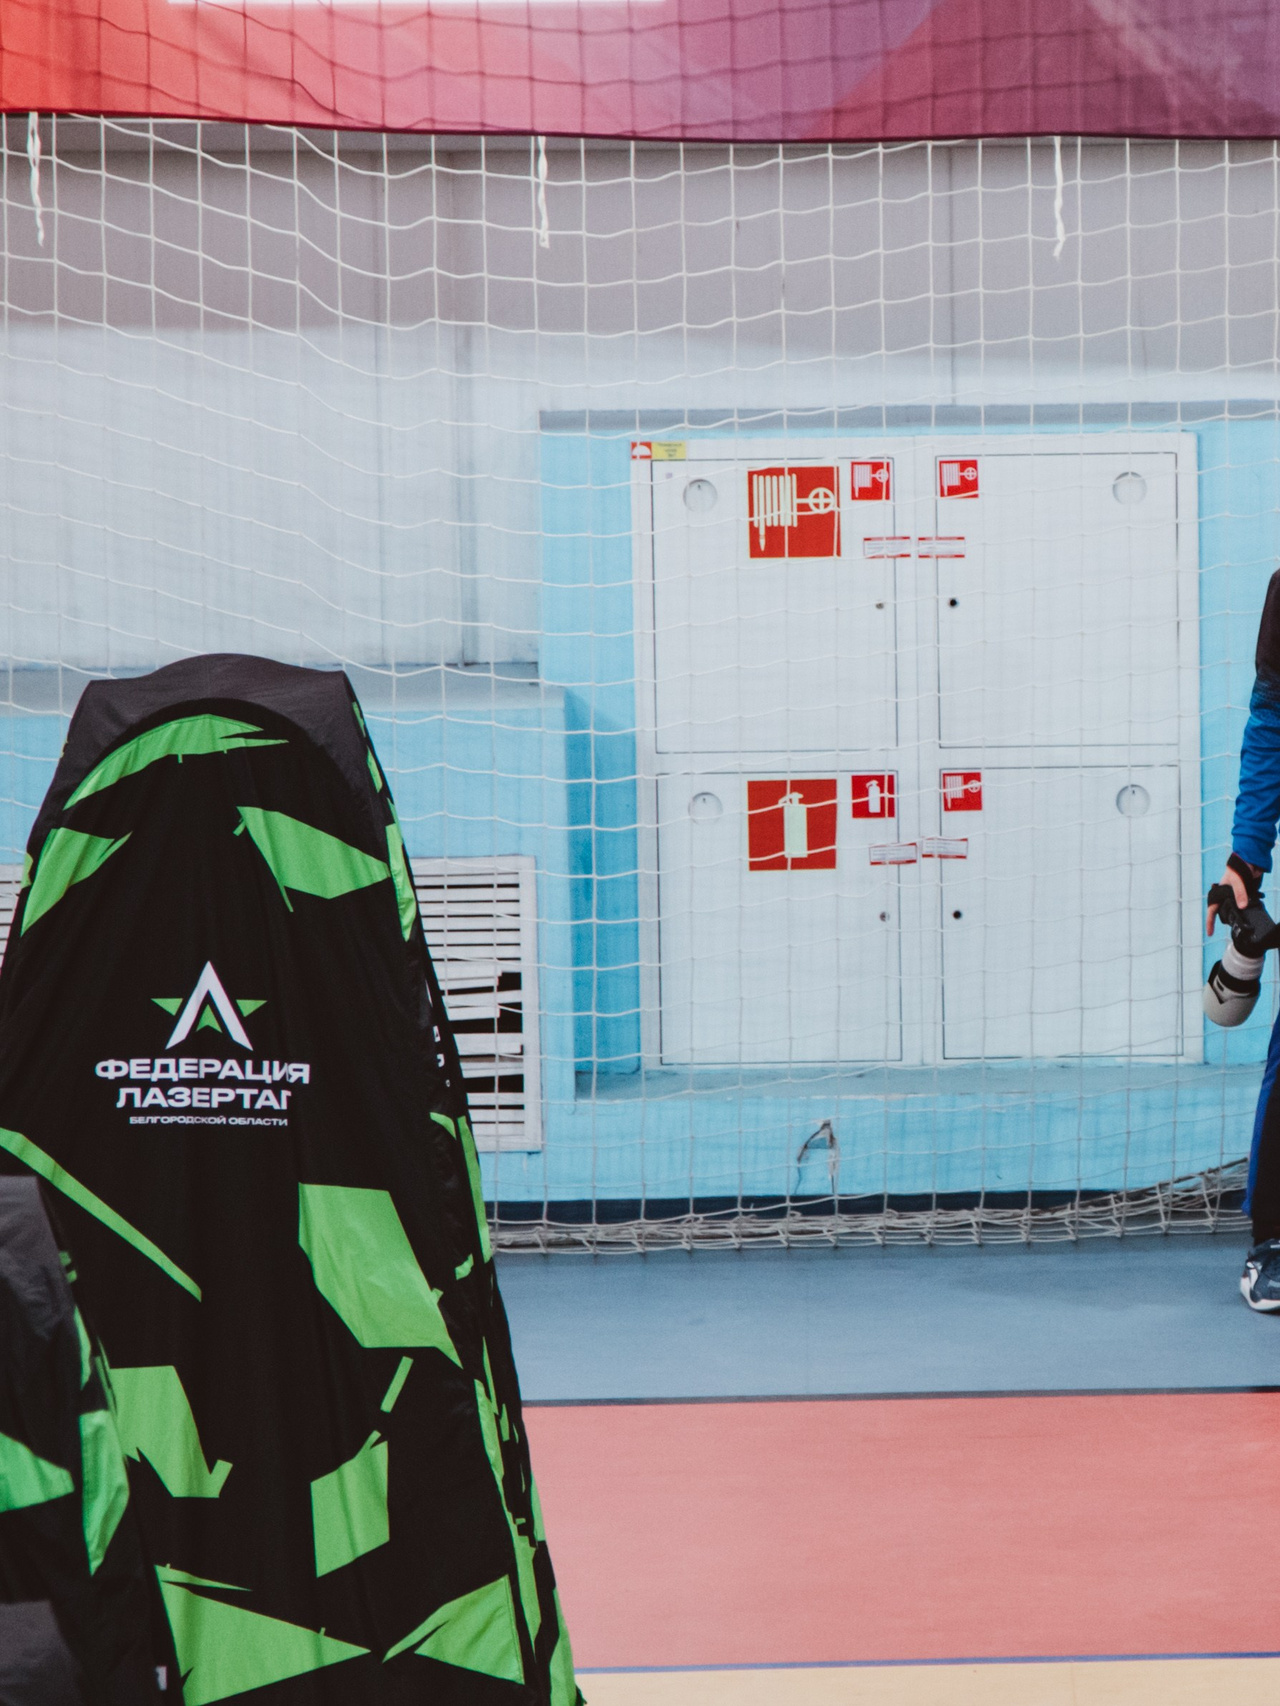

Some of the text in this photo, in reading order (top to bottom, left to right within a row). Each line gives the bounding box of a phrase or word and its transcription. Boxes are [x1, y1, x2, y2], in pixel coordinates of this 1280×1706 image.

[95, 1058, 310, 1084] ФЕДЕРАЦИЯ
[116, 1087, 292, 1110] ЛАЗЕРТАГ
[129, 1116, 288, 1126] БЕЛГОРОДСКОЙ ОБЛАСТИ
